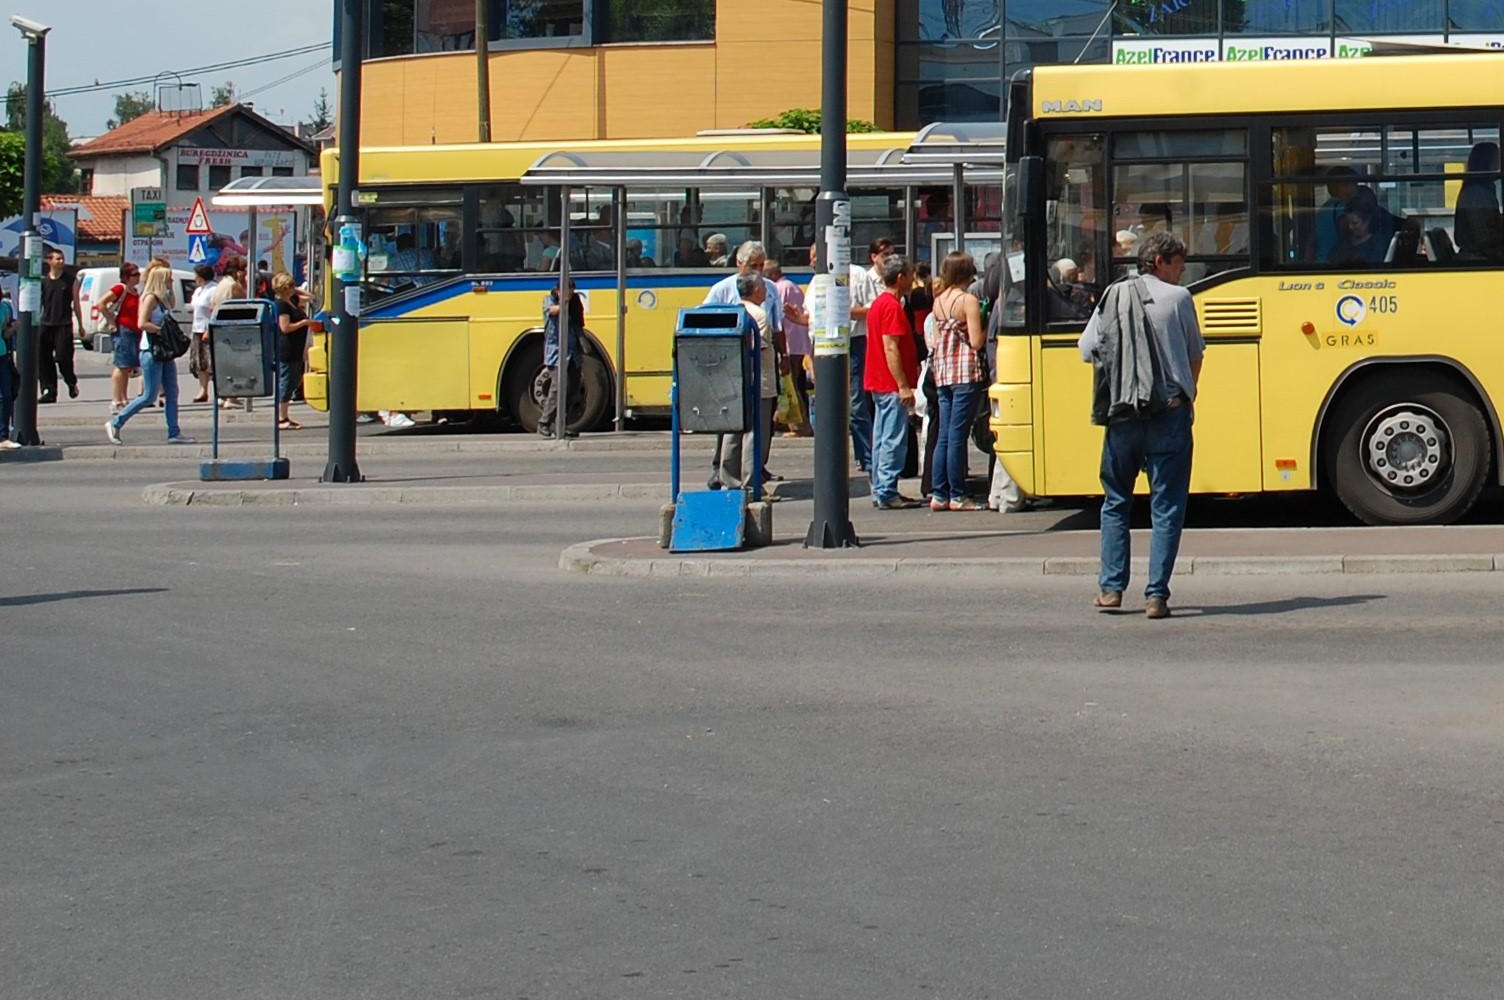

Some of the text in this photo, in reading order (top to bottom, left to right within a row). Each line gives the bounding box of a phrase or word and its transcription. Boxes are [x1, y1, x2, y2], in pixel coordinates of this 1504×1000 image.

[1042, 98, 1103, 113] MAN
[141, 189, 162, 201] TAXI
[1337, 279, 1397, 290] Classic
[1368, 295, 1398, 313] 405
[1326, 334, 1375, 347] GRAS
